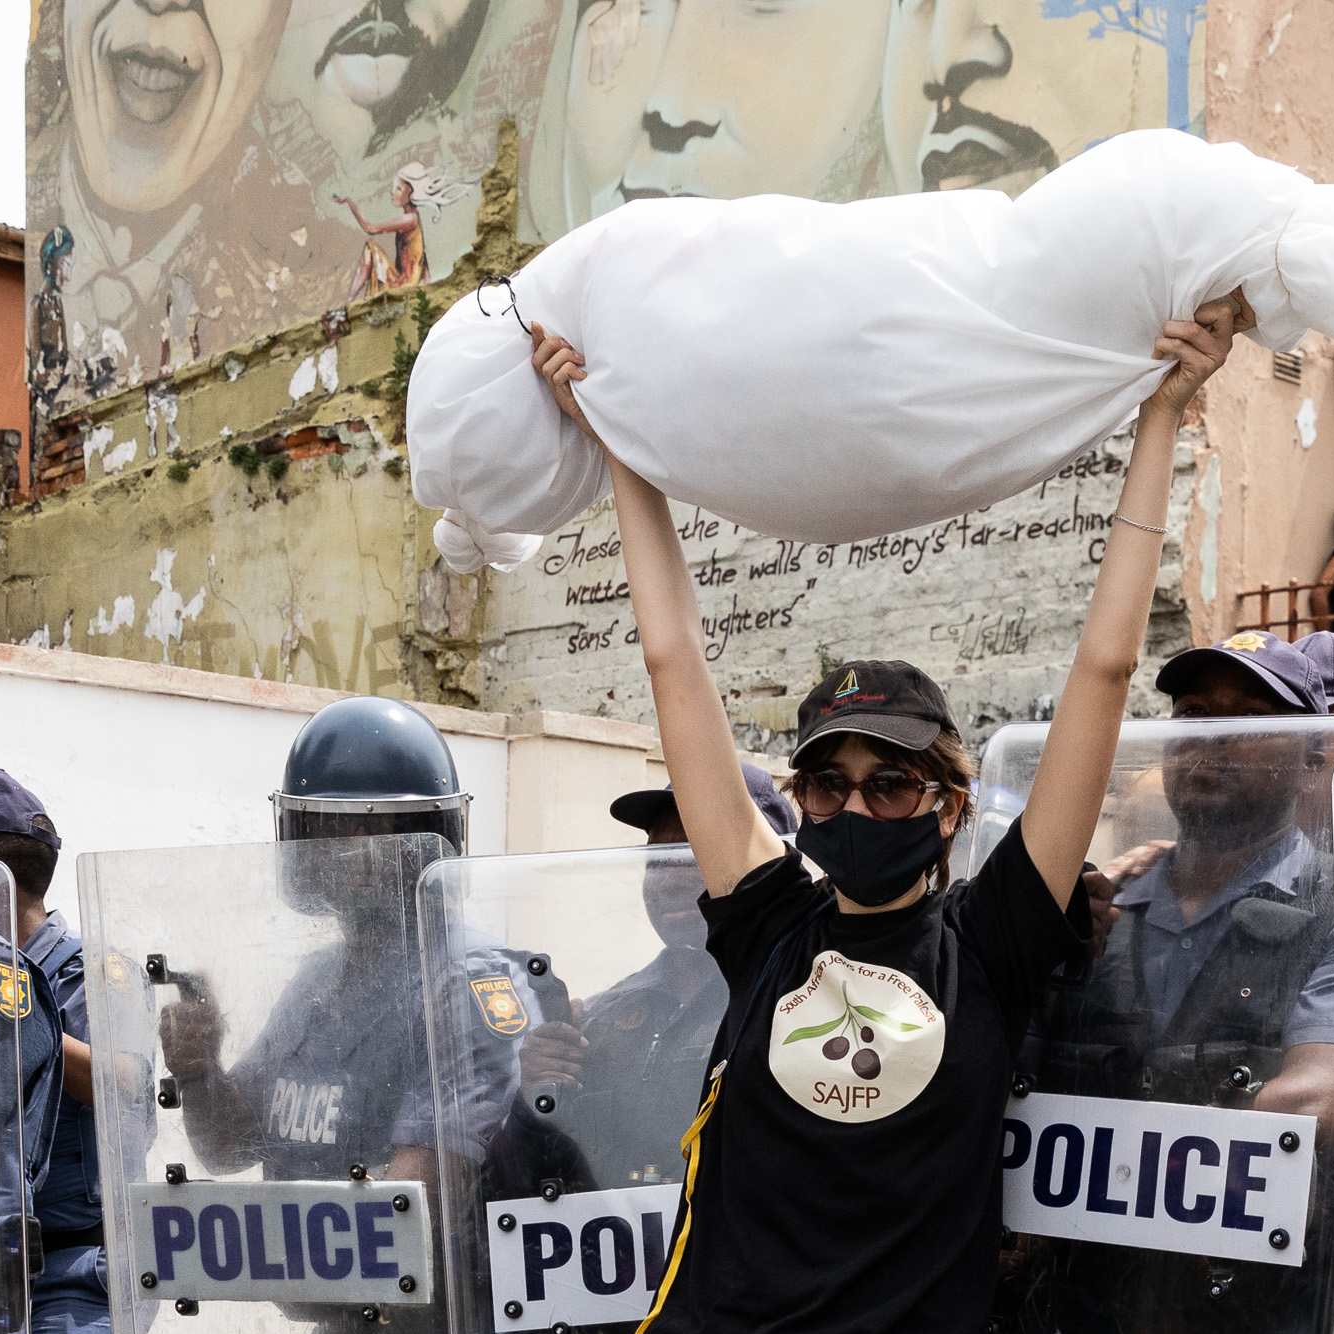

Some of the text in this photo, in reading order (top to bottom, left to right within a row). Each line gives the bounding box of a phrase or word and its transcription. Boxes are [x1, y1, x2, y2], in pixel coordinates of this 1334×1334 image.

[543, 526, 621, 576] These
[678, 506, 719, 541] the
[565, 580, 630, 607] writte
[694, 548, 737, 587] the
[749, 540, 810, 580] walls
[817, 542, 840, 568] of
[475, 981, 511, 993] POLICE
[779, 992, 808, 1015] South
[806, 960, 827, 996] Afrian
[829, 954, 855, 972] Jews
[857, 965, 877, 978] for
[878, 972, 886, 981] a
[887, 973, 912, 994] Free
[268, 1077, 344, 1144] POLICE
[812, 1081, 881, 1114] SAJFP
[152, 1201, 399, 1281] POLICE
[522, 1211, 667, 1302] POL
